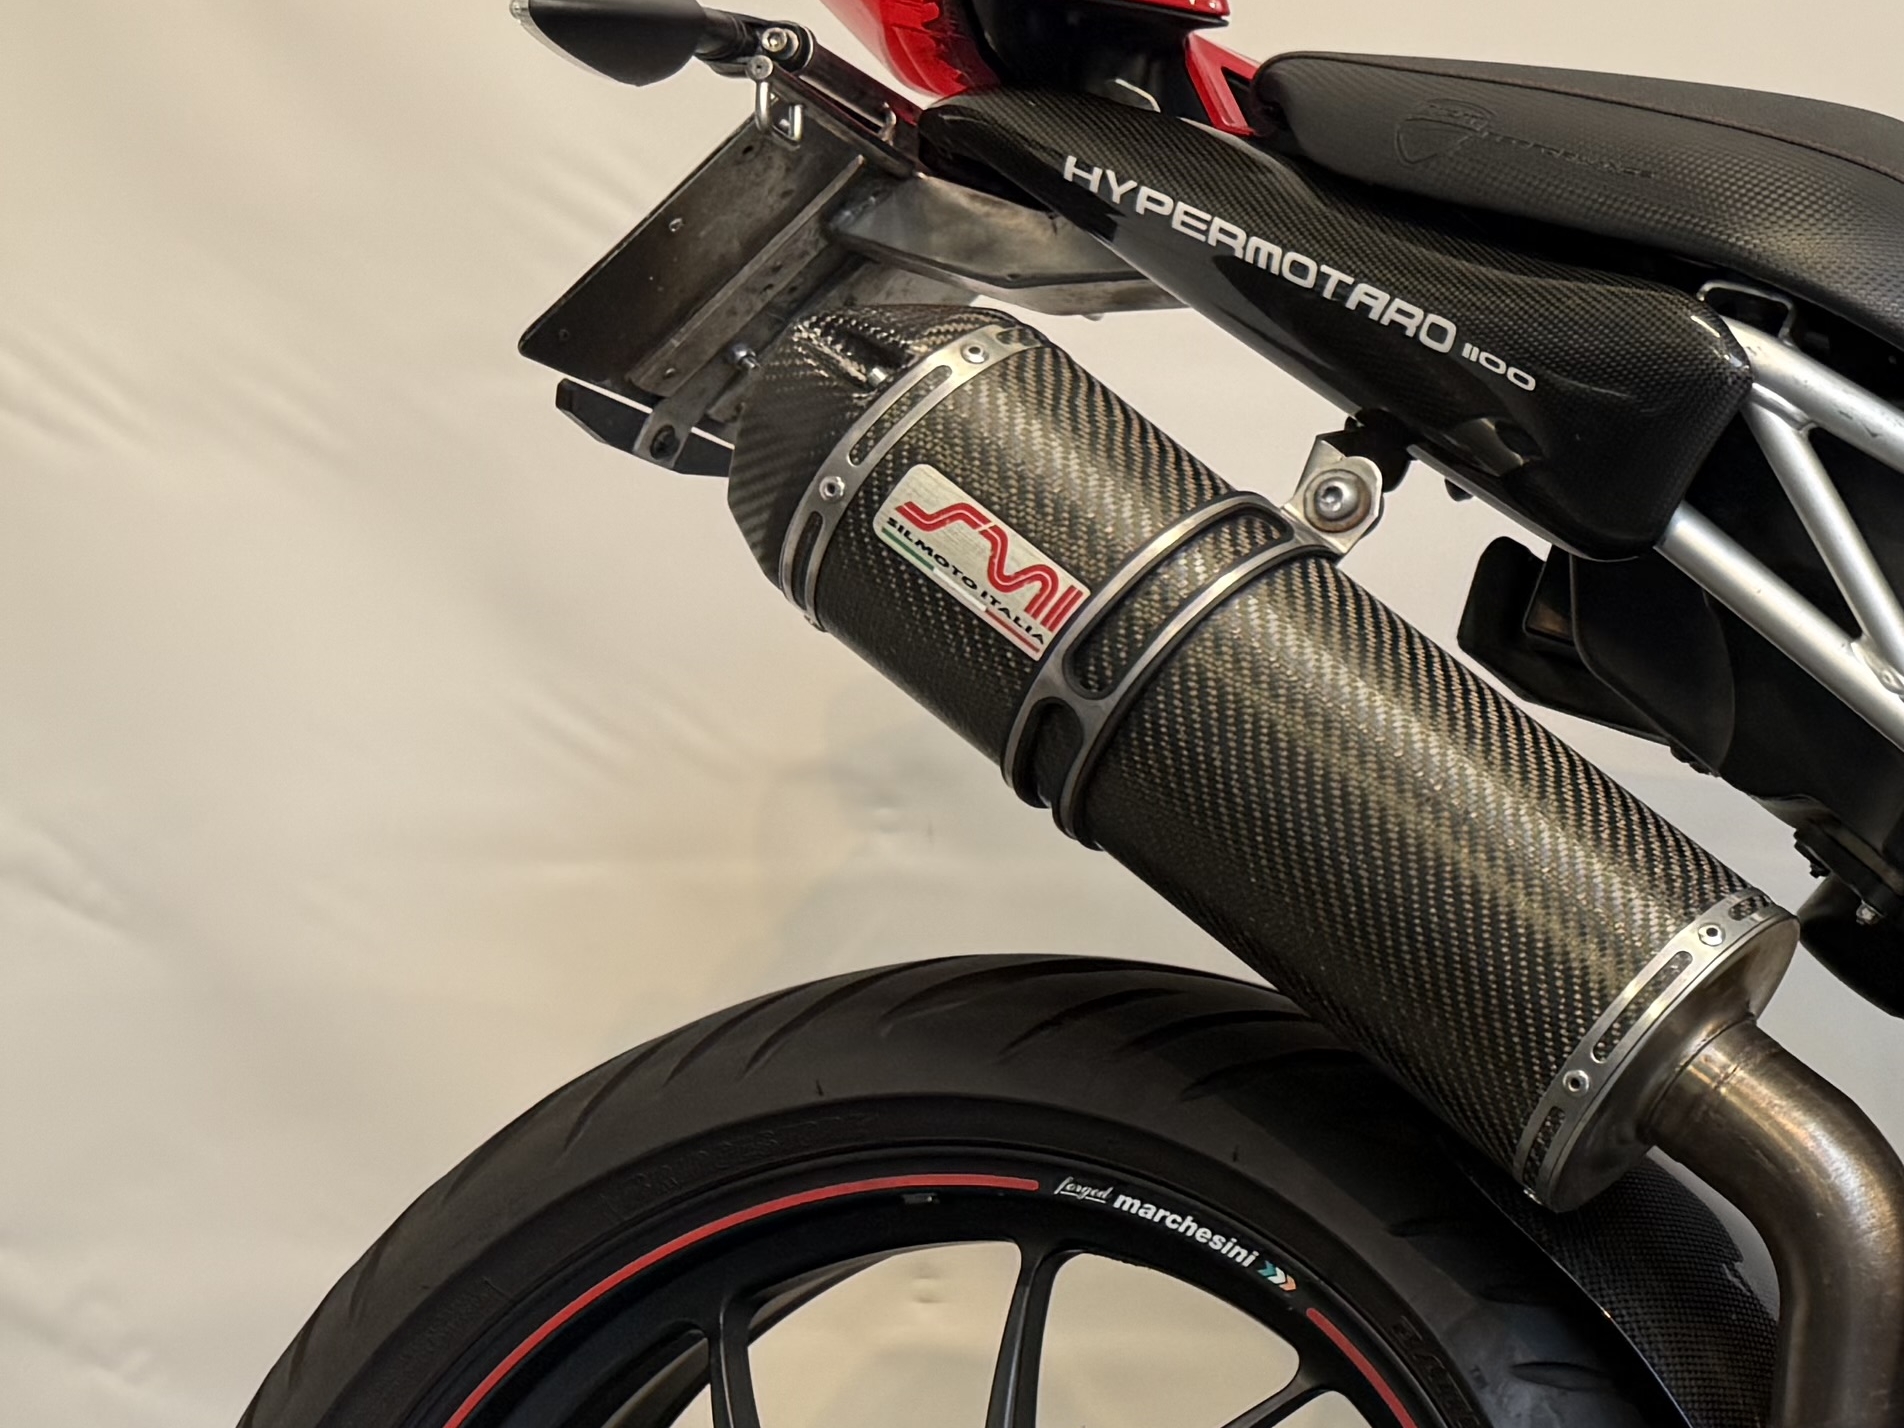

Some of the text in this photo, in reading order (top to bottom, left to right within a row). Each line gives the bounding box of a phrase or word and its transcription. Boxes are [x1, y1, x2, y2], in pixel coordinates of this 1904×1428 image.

[1462, 343, 1536, 391] 1100
[887, 517, 1045, 645] SILMOTO ITALIA
[1054, 1176, 1259, 1268] forged marchesini
